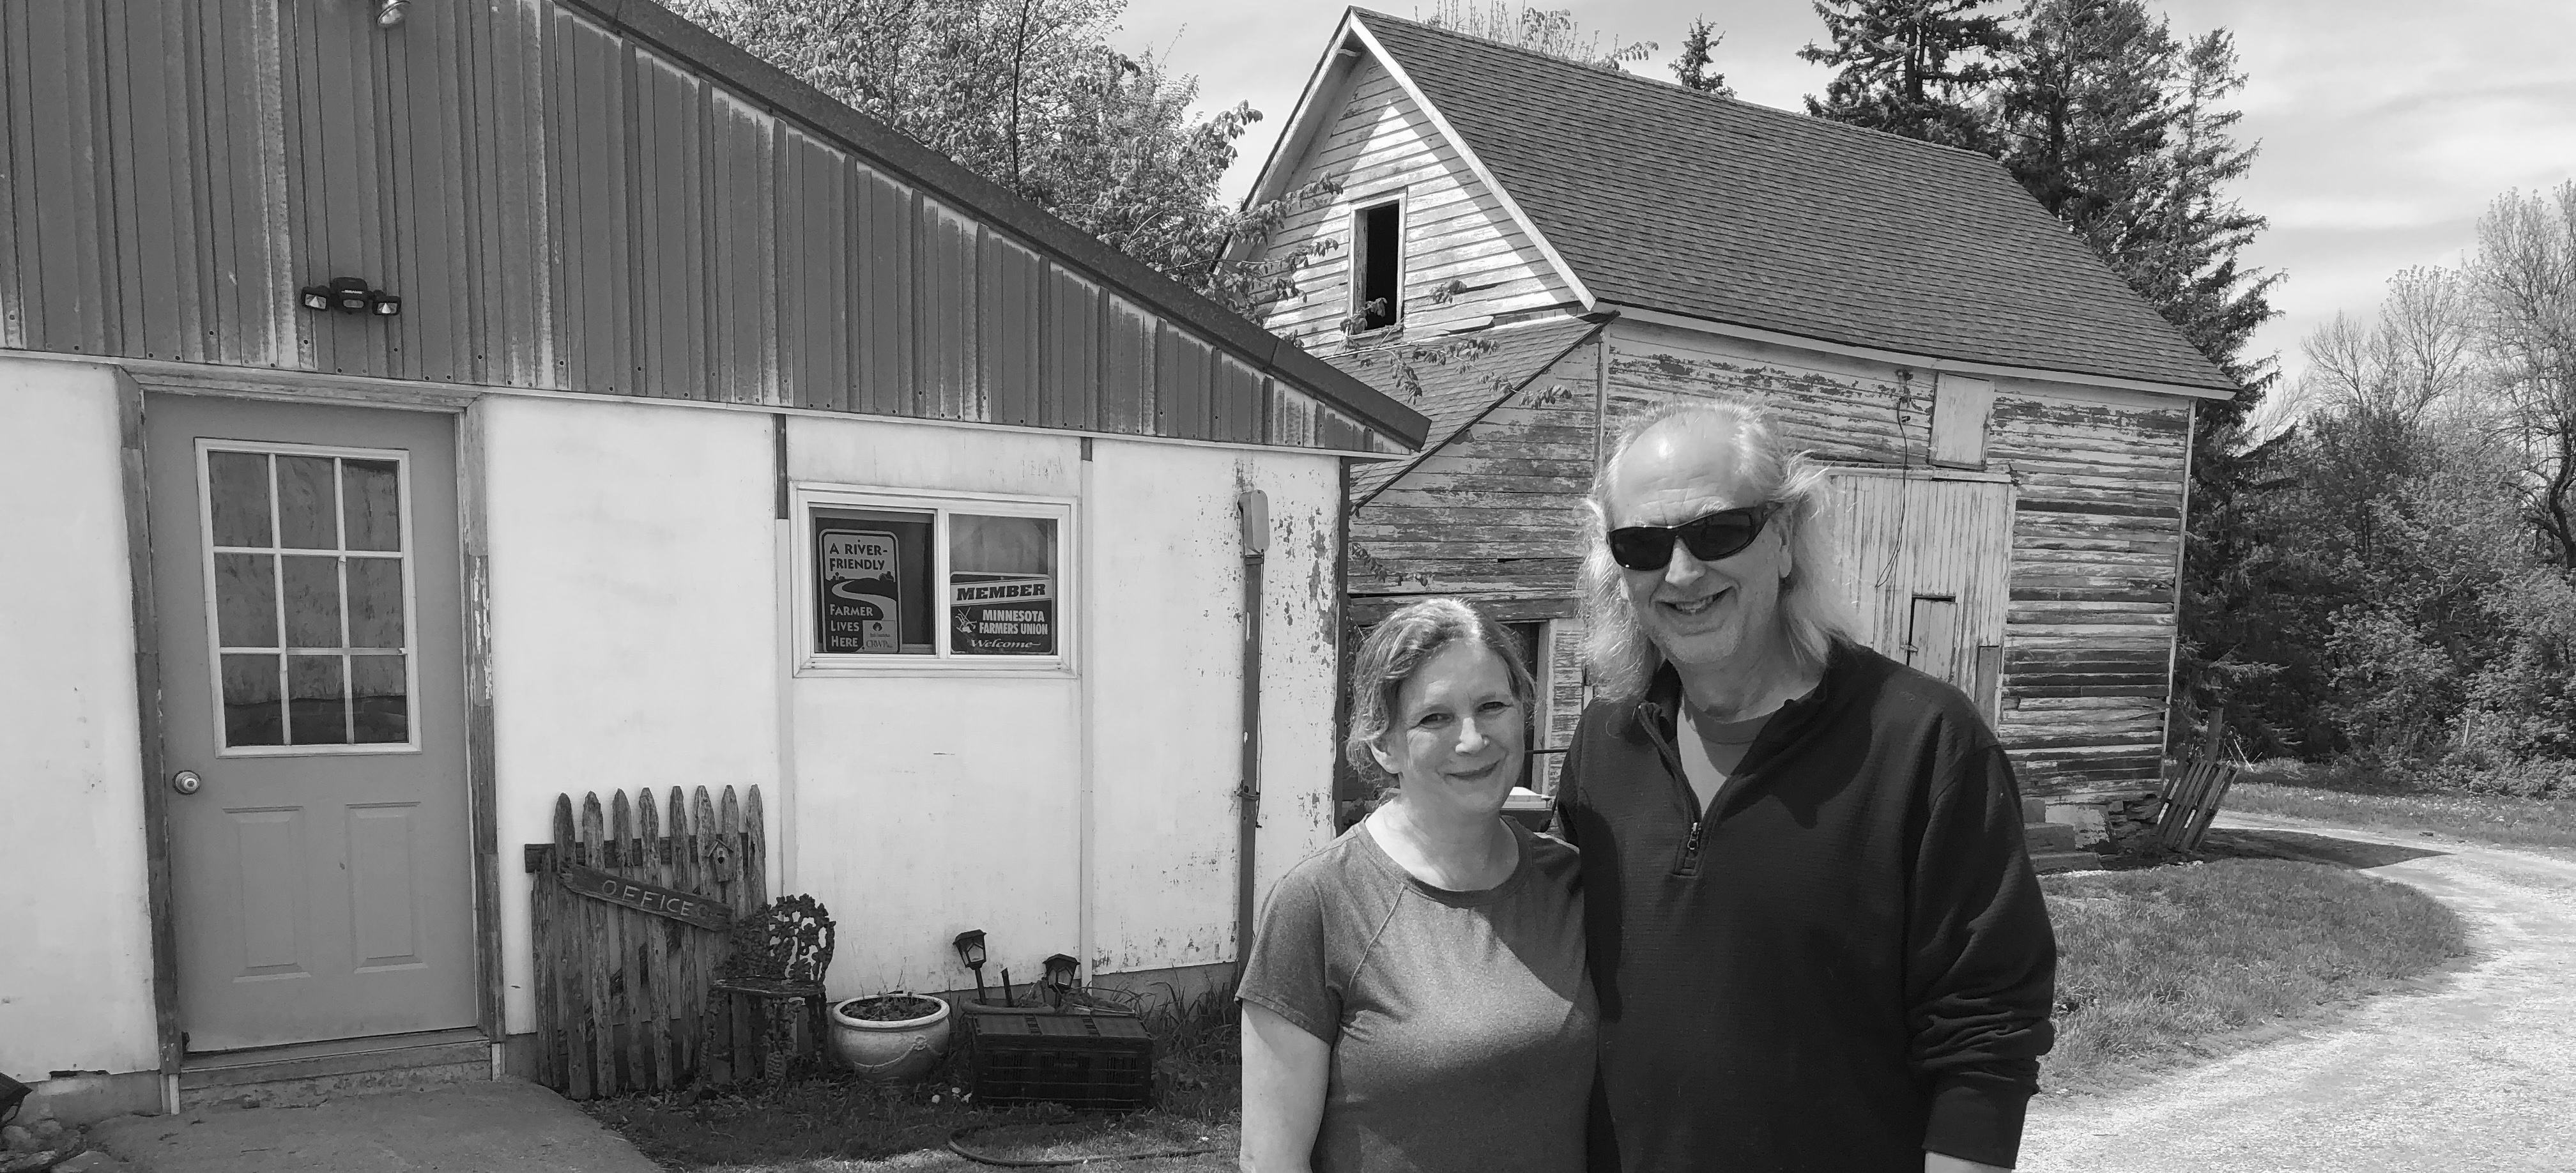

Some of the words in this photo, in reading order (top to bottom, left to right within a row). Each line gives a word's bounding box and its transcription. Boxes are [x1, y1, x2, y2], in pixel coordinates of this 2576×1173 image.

[829, 542, 839, 555] A
[845, 543, 888, 556] RIVER-
[829, 558, 885, 571] FRIENDLY
[956, 583, 1046, 601] MEMBER
[829, 604, 873, 617] FARMER
[982, 609, 1045, 622] MINNESOTA
[831, 620, 860, 632] LIVES
[979, 622, 1018, 634] FARMERS
[1020, 623, 1048, 635] UNION
[831, 635, 858, 647] HERE
[970, 638, 1041, 648] Welcome
[602, 879, 694, 916] OFFICE
